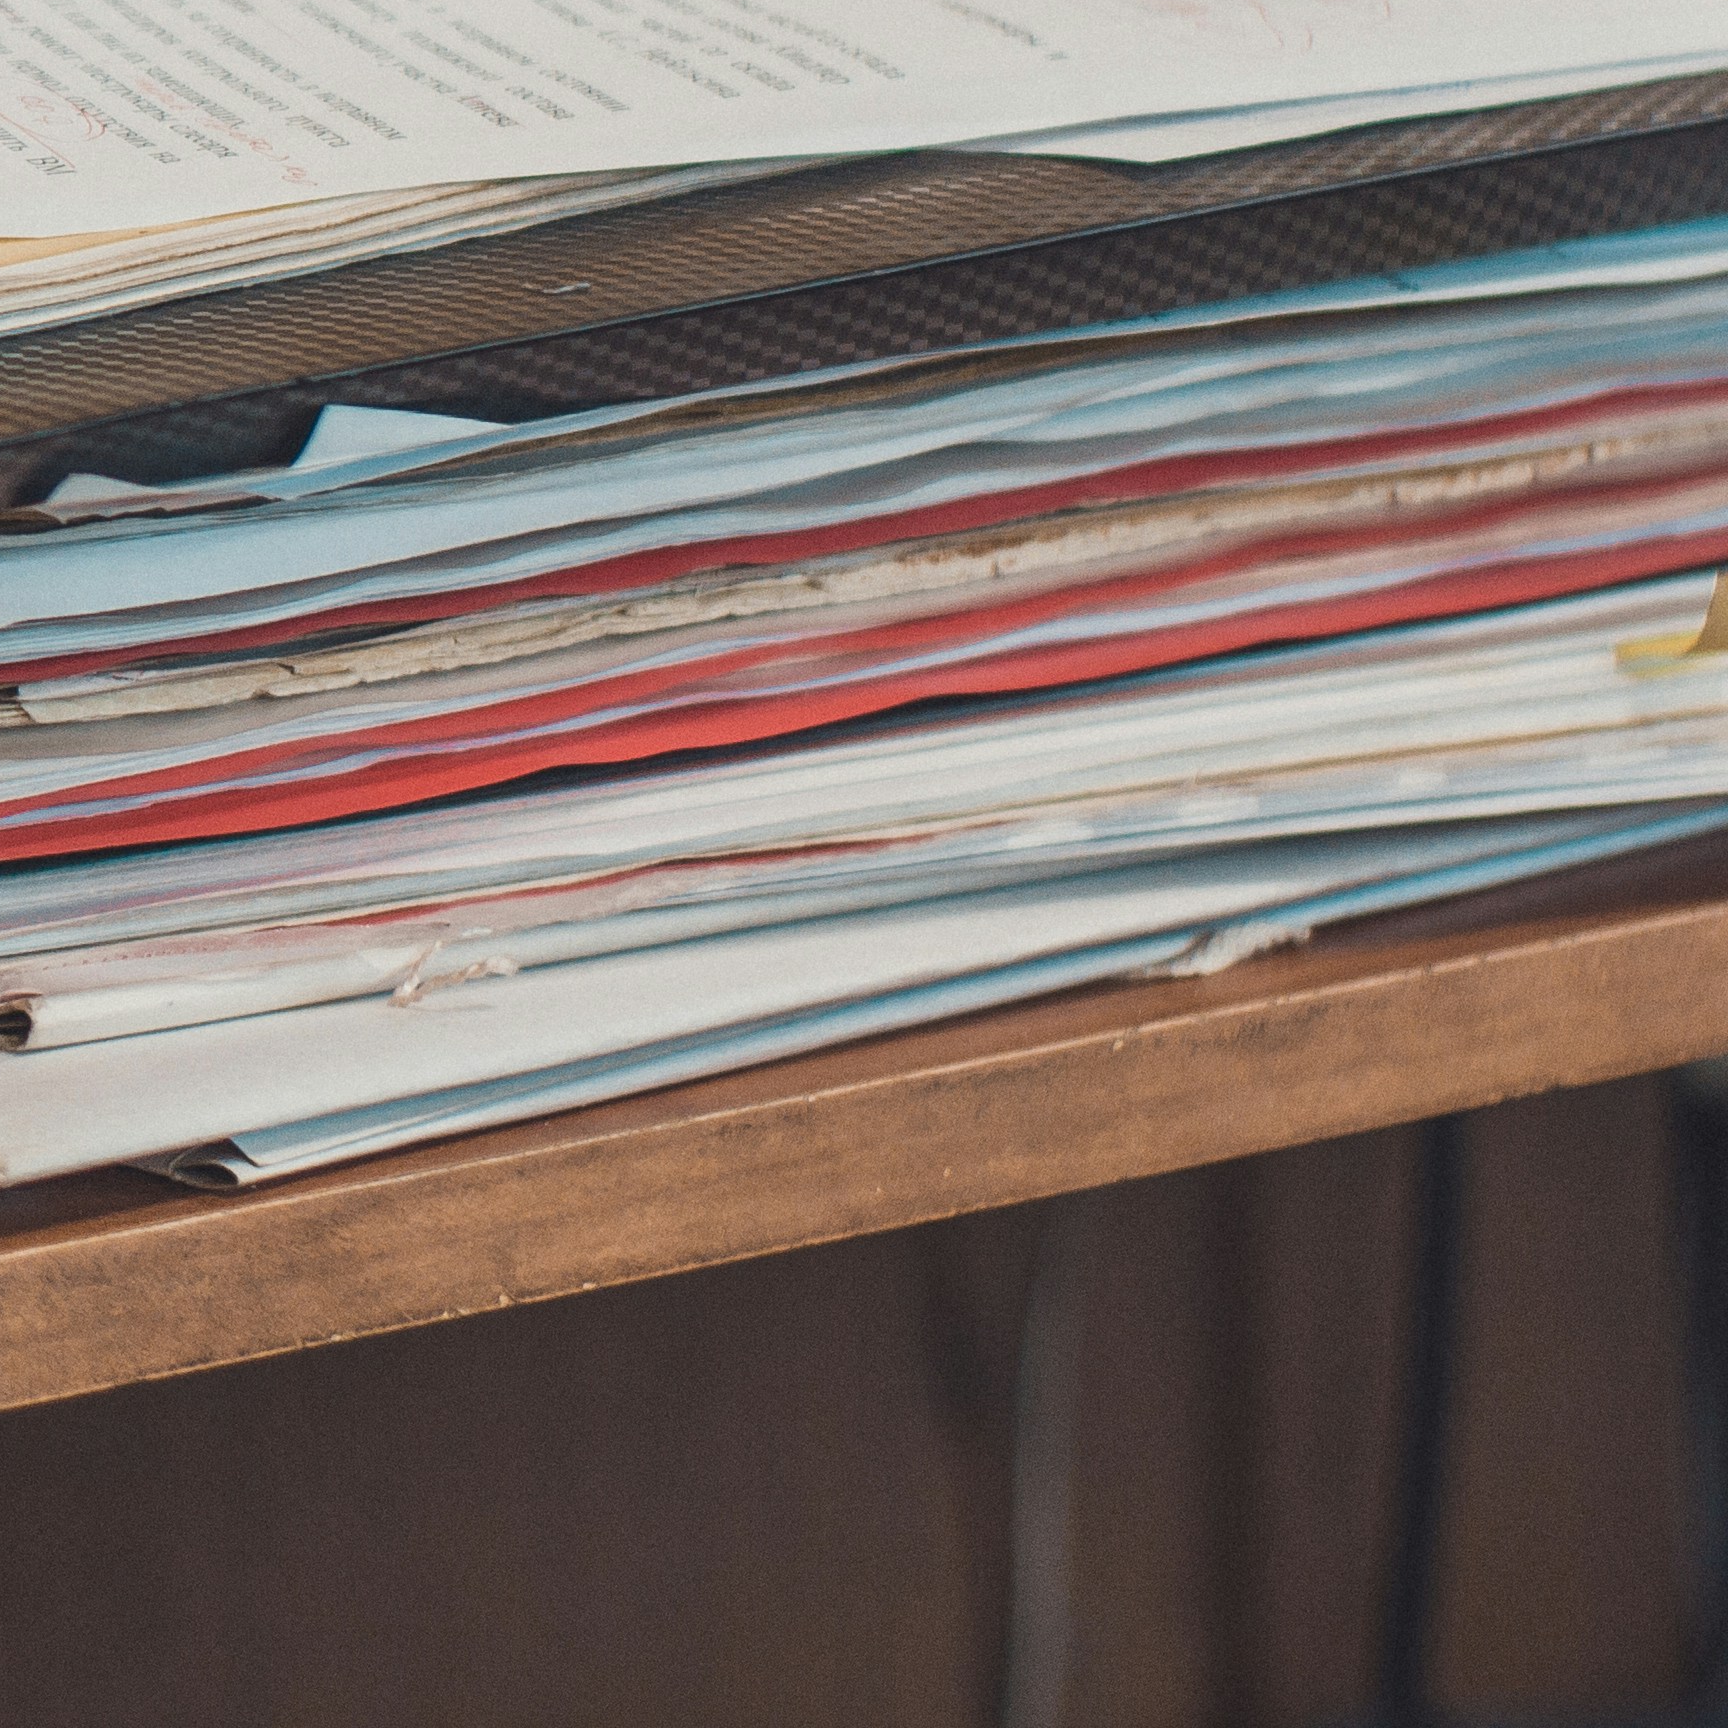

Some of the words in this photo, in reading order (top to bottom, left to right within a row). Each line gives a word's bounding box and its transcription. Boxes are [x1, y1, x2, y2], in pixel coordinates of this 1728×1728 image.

[181, 48, 290, 113] контрольного
[284, 114, 351, 149] пункта
[314, 92, 408, 142] исправном
[64, 95, 158, 150] отсутствия
[149, 149, 182, 165] на
[169, 124, 239, 159] слесаря
[25, 155, 77, 177] ВМ
